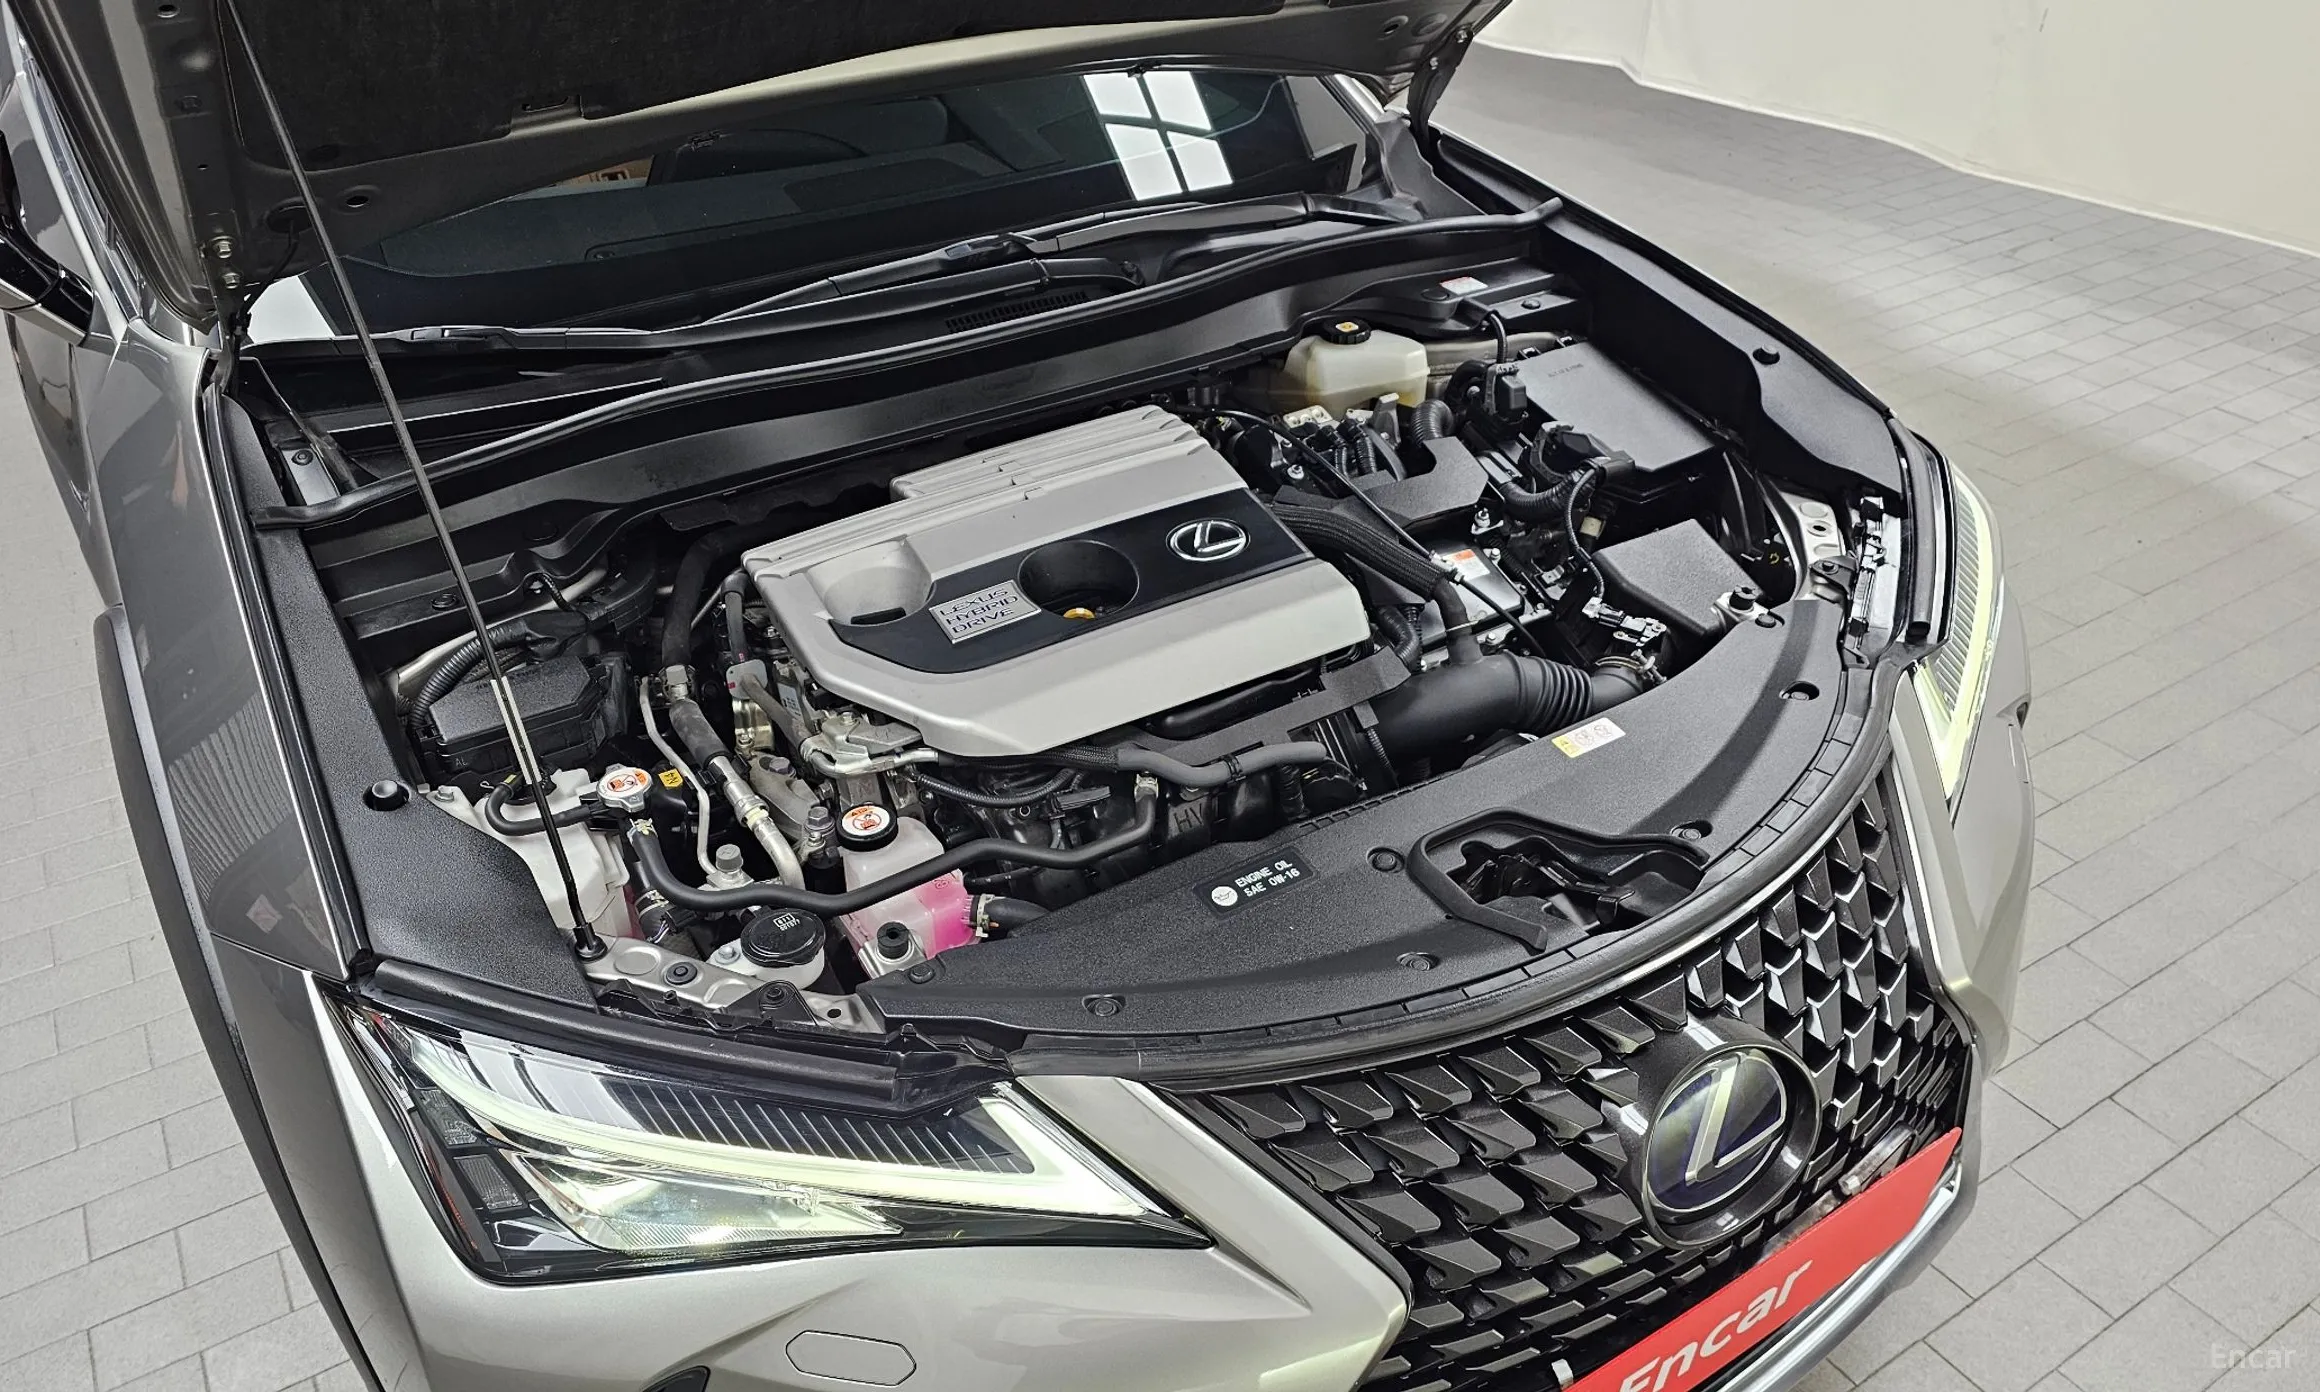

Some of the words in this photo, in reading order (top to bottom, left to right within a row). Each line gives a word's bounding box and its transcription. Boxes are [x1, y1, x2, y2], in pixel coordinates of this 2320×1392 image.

[940, 588, 1008, 616] LEXUS
[946, 596, 1018, 625] HYBRID
[952, 607, 1014, 633] DRIVE
[1235, 867, 1273, 888] ENGINE
[1274, 860, 1293, 871] OIL
[1243, 882, 1267, 897] SAE
[1268, 868, 1300, 886] 0W-16
